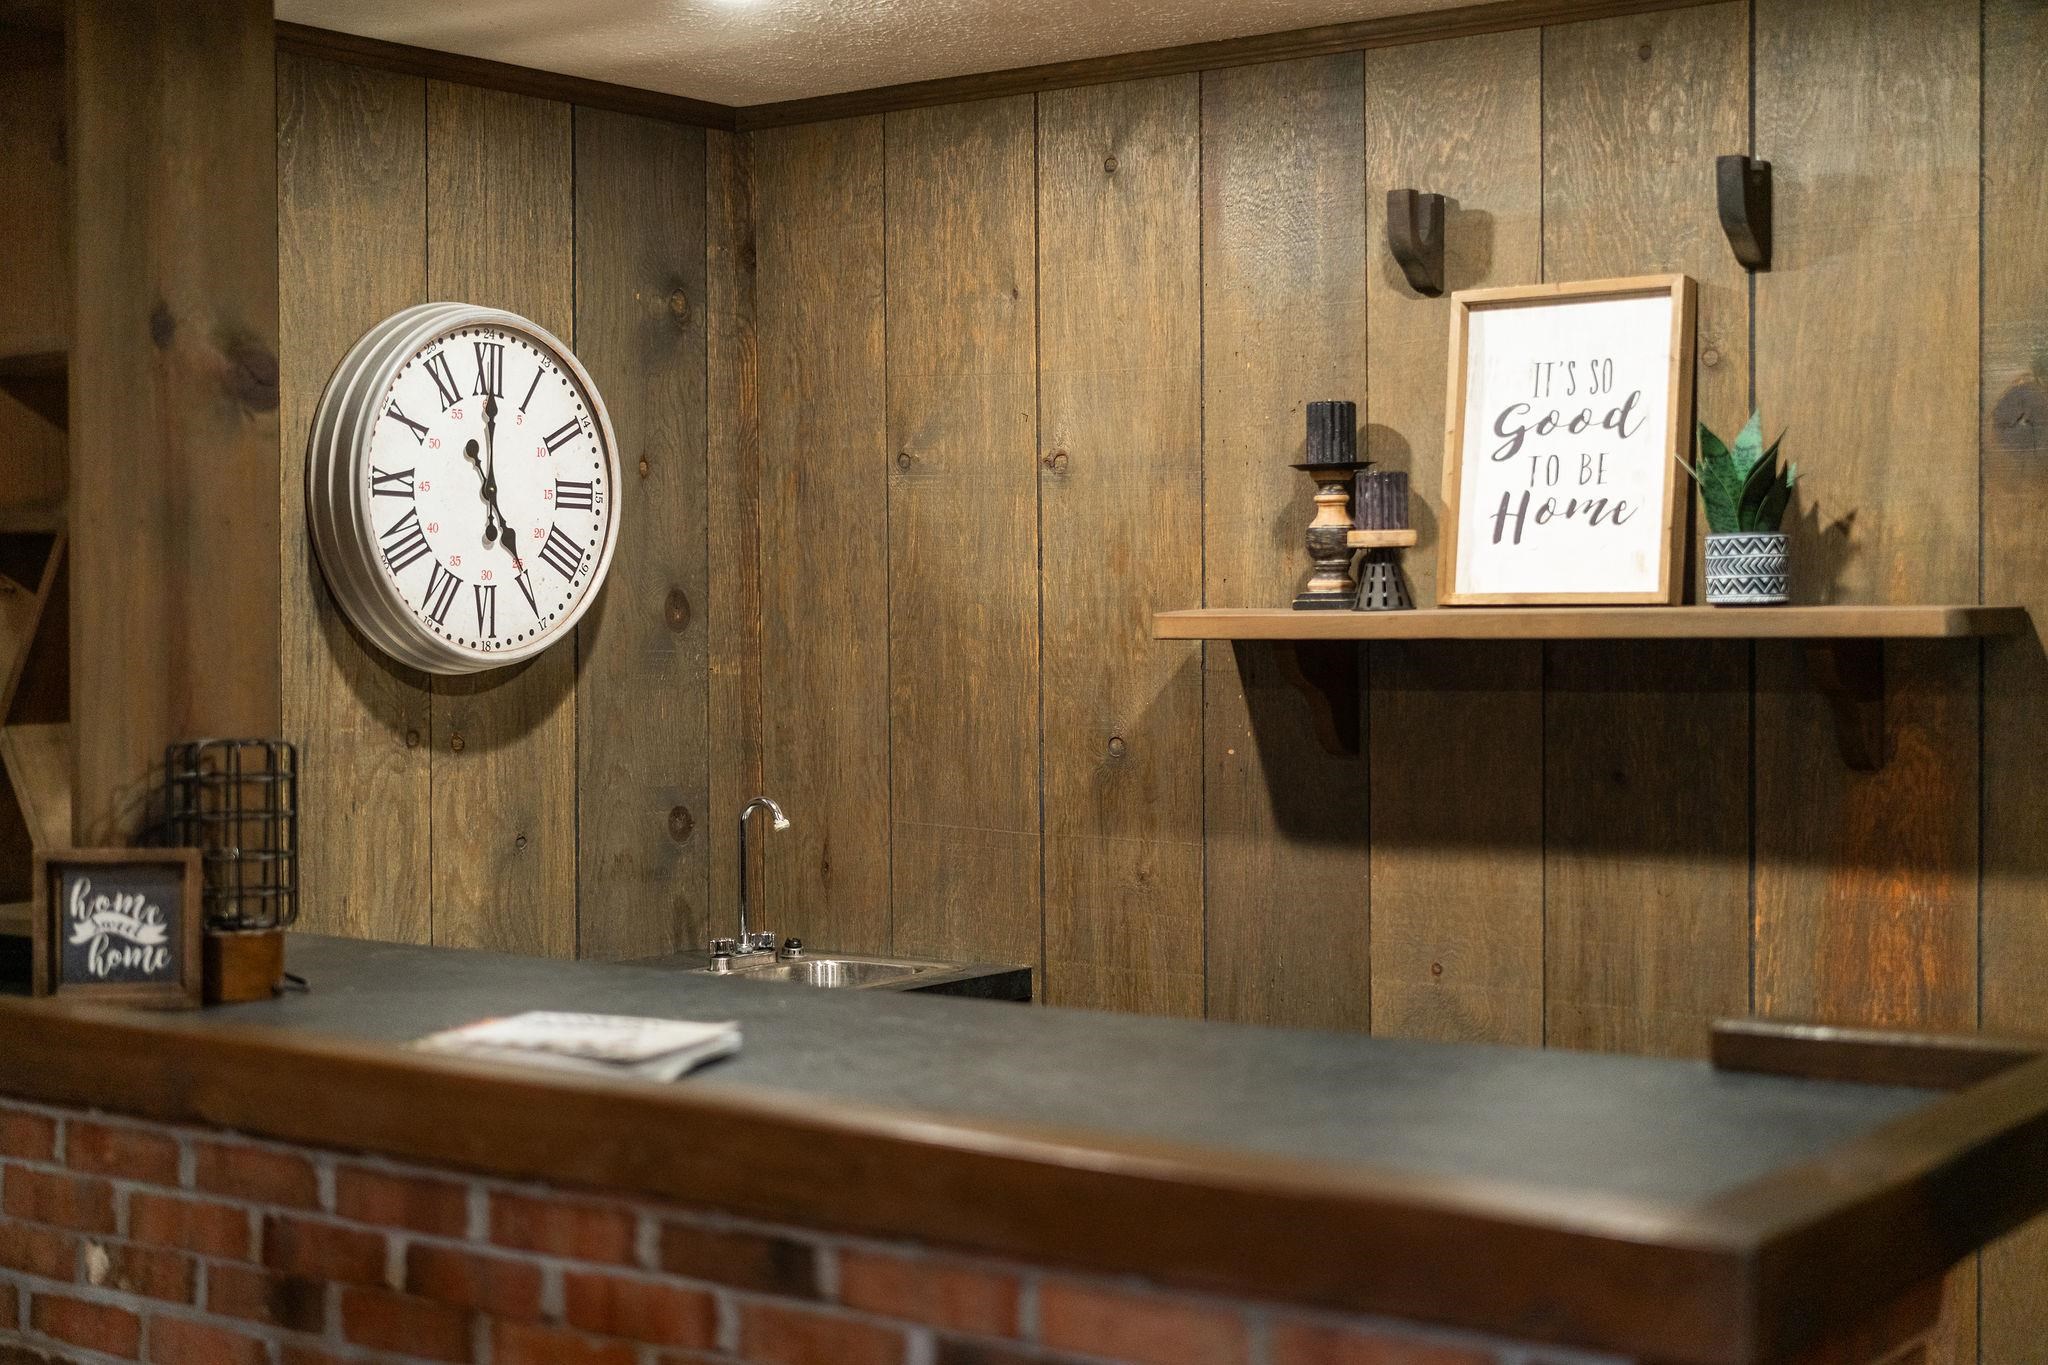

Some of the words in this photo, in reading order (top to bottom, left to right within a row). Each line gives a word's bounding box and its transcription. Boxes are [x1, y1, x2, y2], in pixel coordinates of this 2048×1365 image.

[483, 328, 495, 340] 24
[424, 340, 437, 355] 23
[472, 342, 505, 399] XII
[541, 355, 552, 368] 13
[423, 350, 463, 413] XI
[518, 366, 546, 414] I
[1532, 360, 1576, 398] IT'S
[1589, 358, 1613, 395] SO
[386, 399, 430, 446] X
[451, 409, 463, 420] 55
[516, 414, 523, 426] 5
[580, 415, 591, 428] 14
[1490, 390, 1647, 462] Good
[429, 438, 441, 449] 50
[543, 415, 583, 456] II
[536, 447, 546, 458] 10
[1529, 454, 1560, 488] TO
[1578, 452, 1610, 486] BE
[372, 465, 415, 501] IX
[418, 481, 431, 492] 45
[543, 489, 553, 500] 15
[555, 478, 593, 512] III
[595, 491, 603, 504] 15
[427, 522, 439, 534] 40
[1489, 489, 1639, 545] Home
[379, 506, 432, 576] VIII
[534, 528, 545, 539] 20
[449, 555, 461, 567] 35
[538, 521, 586, 584] IIII
[481, 569, 493, 580] 30
[579, 562, 590, 577] 16
[421, 558, 464, 626] VII
[514, 569, 540, 620] V
[473, 584, 497, 639] VI
[538, 617, 547, 632] 17
[481, 640, 492, 653] 18
[69, 877, 166, 926] home
[88, 933, 172, 977] home
